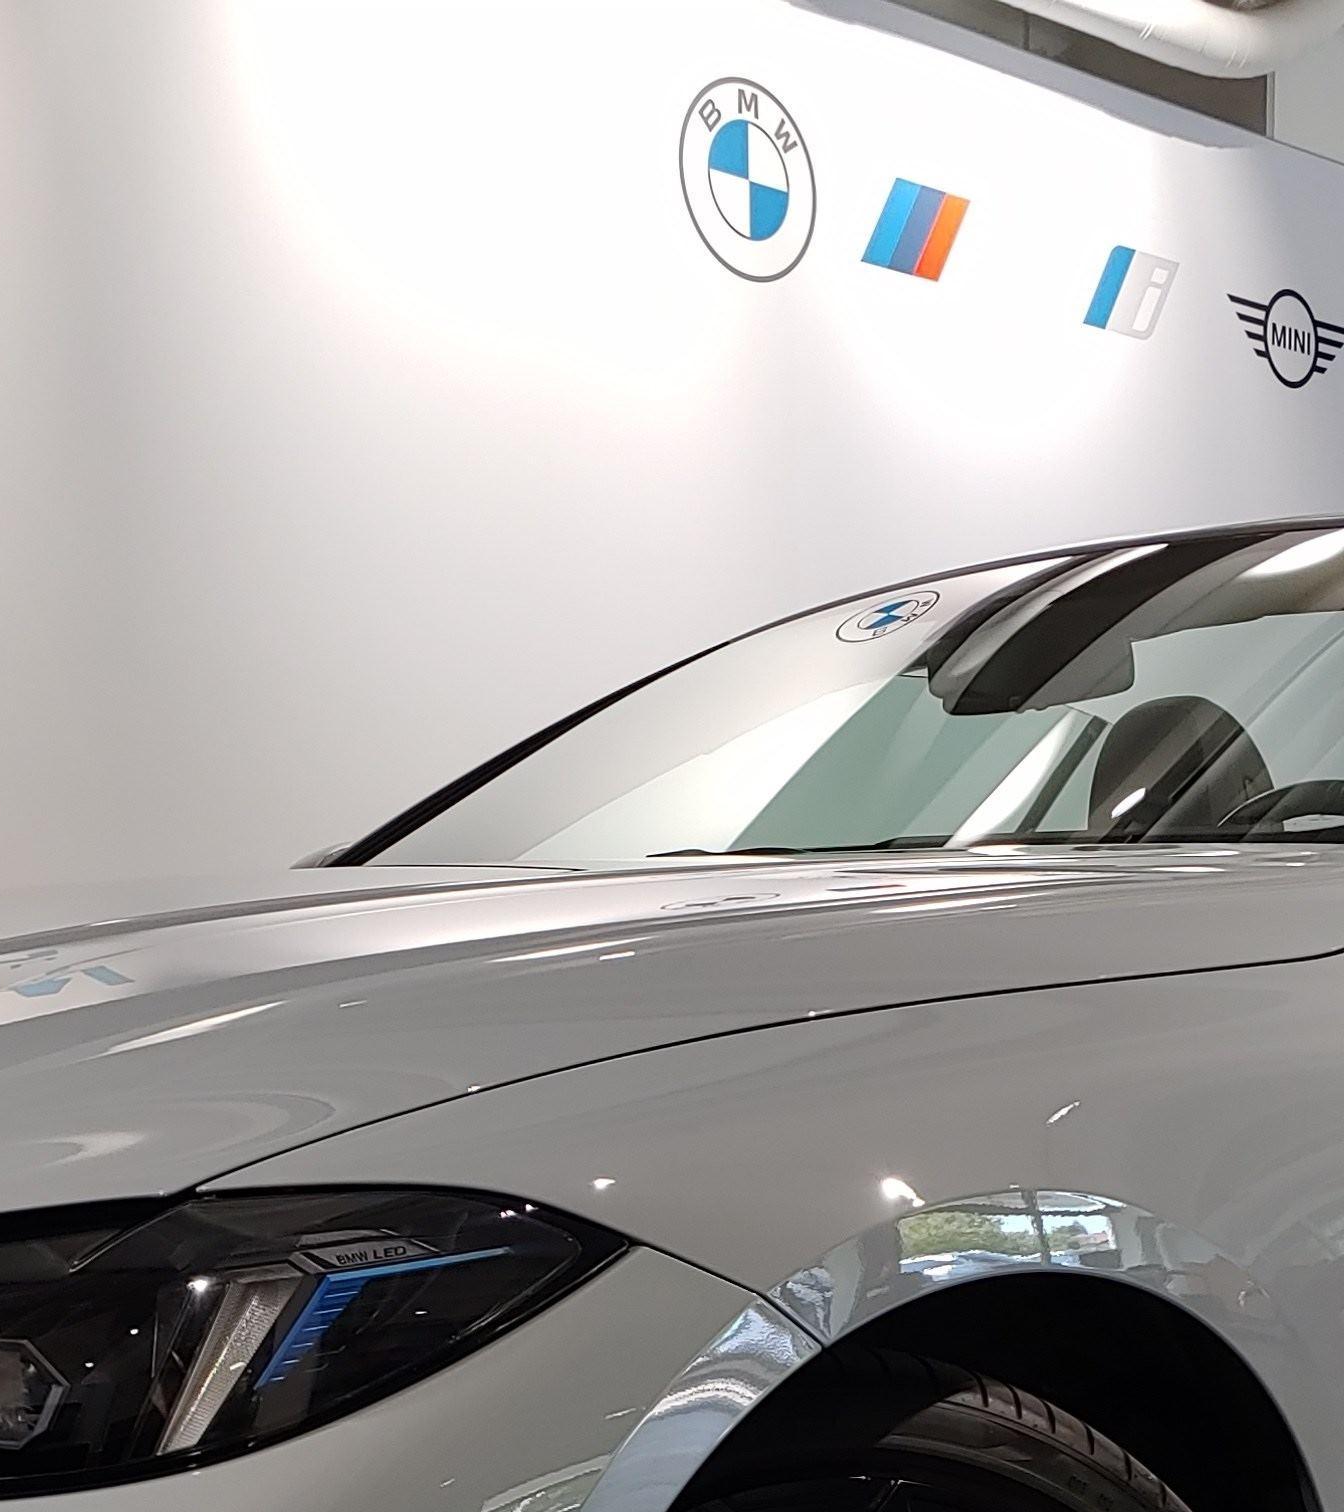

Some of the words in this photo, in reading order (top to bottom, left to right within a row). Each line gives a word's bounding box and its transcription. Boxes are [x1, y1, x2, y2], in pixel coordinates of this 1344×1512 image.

[697, 88, 798, 155] BMW
[1270, 325, 1312, 357] MINI
[334, 1250, 369, 1266] BMW
[372, 1245, 407, 1260] LED
